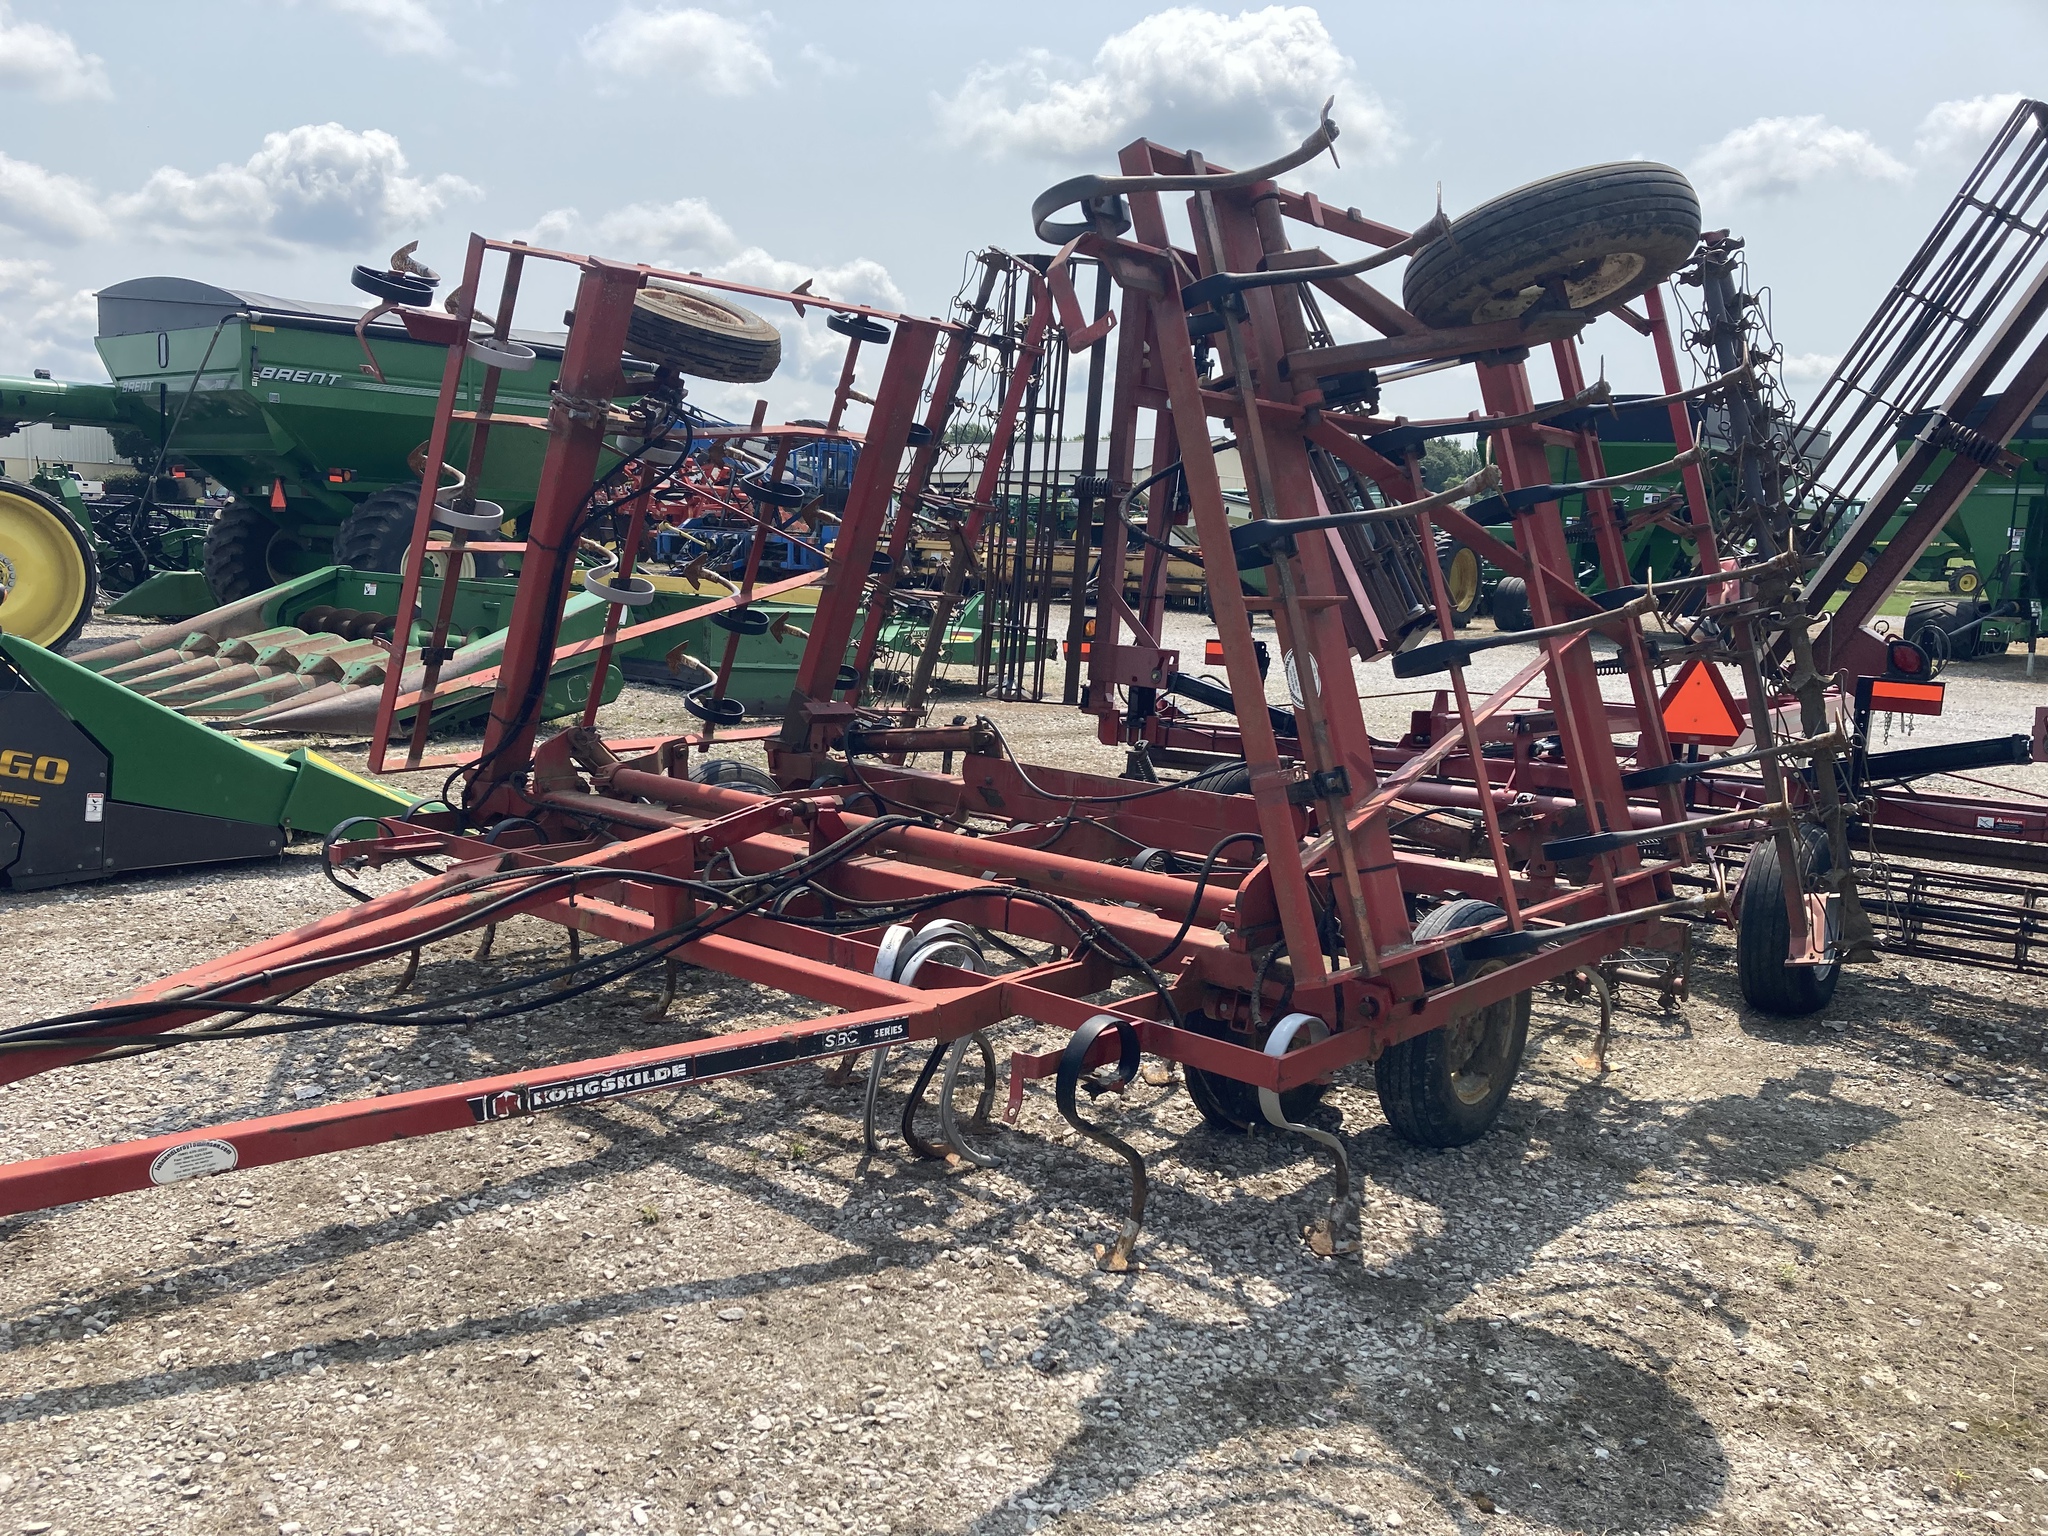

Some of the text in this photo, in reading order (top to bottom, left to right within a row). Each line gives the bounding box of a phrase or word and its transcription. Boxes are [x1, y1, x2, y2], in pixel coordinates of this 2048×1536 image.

[259, 366, 342, 386] BRENT
[121, 380, 154, 393] BRENT
[0, 790, 41, 807] mac
[874, 1024, 903, 1038] SERIES
[533, 1063, 687, 1106] KONGSKILDE
